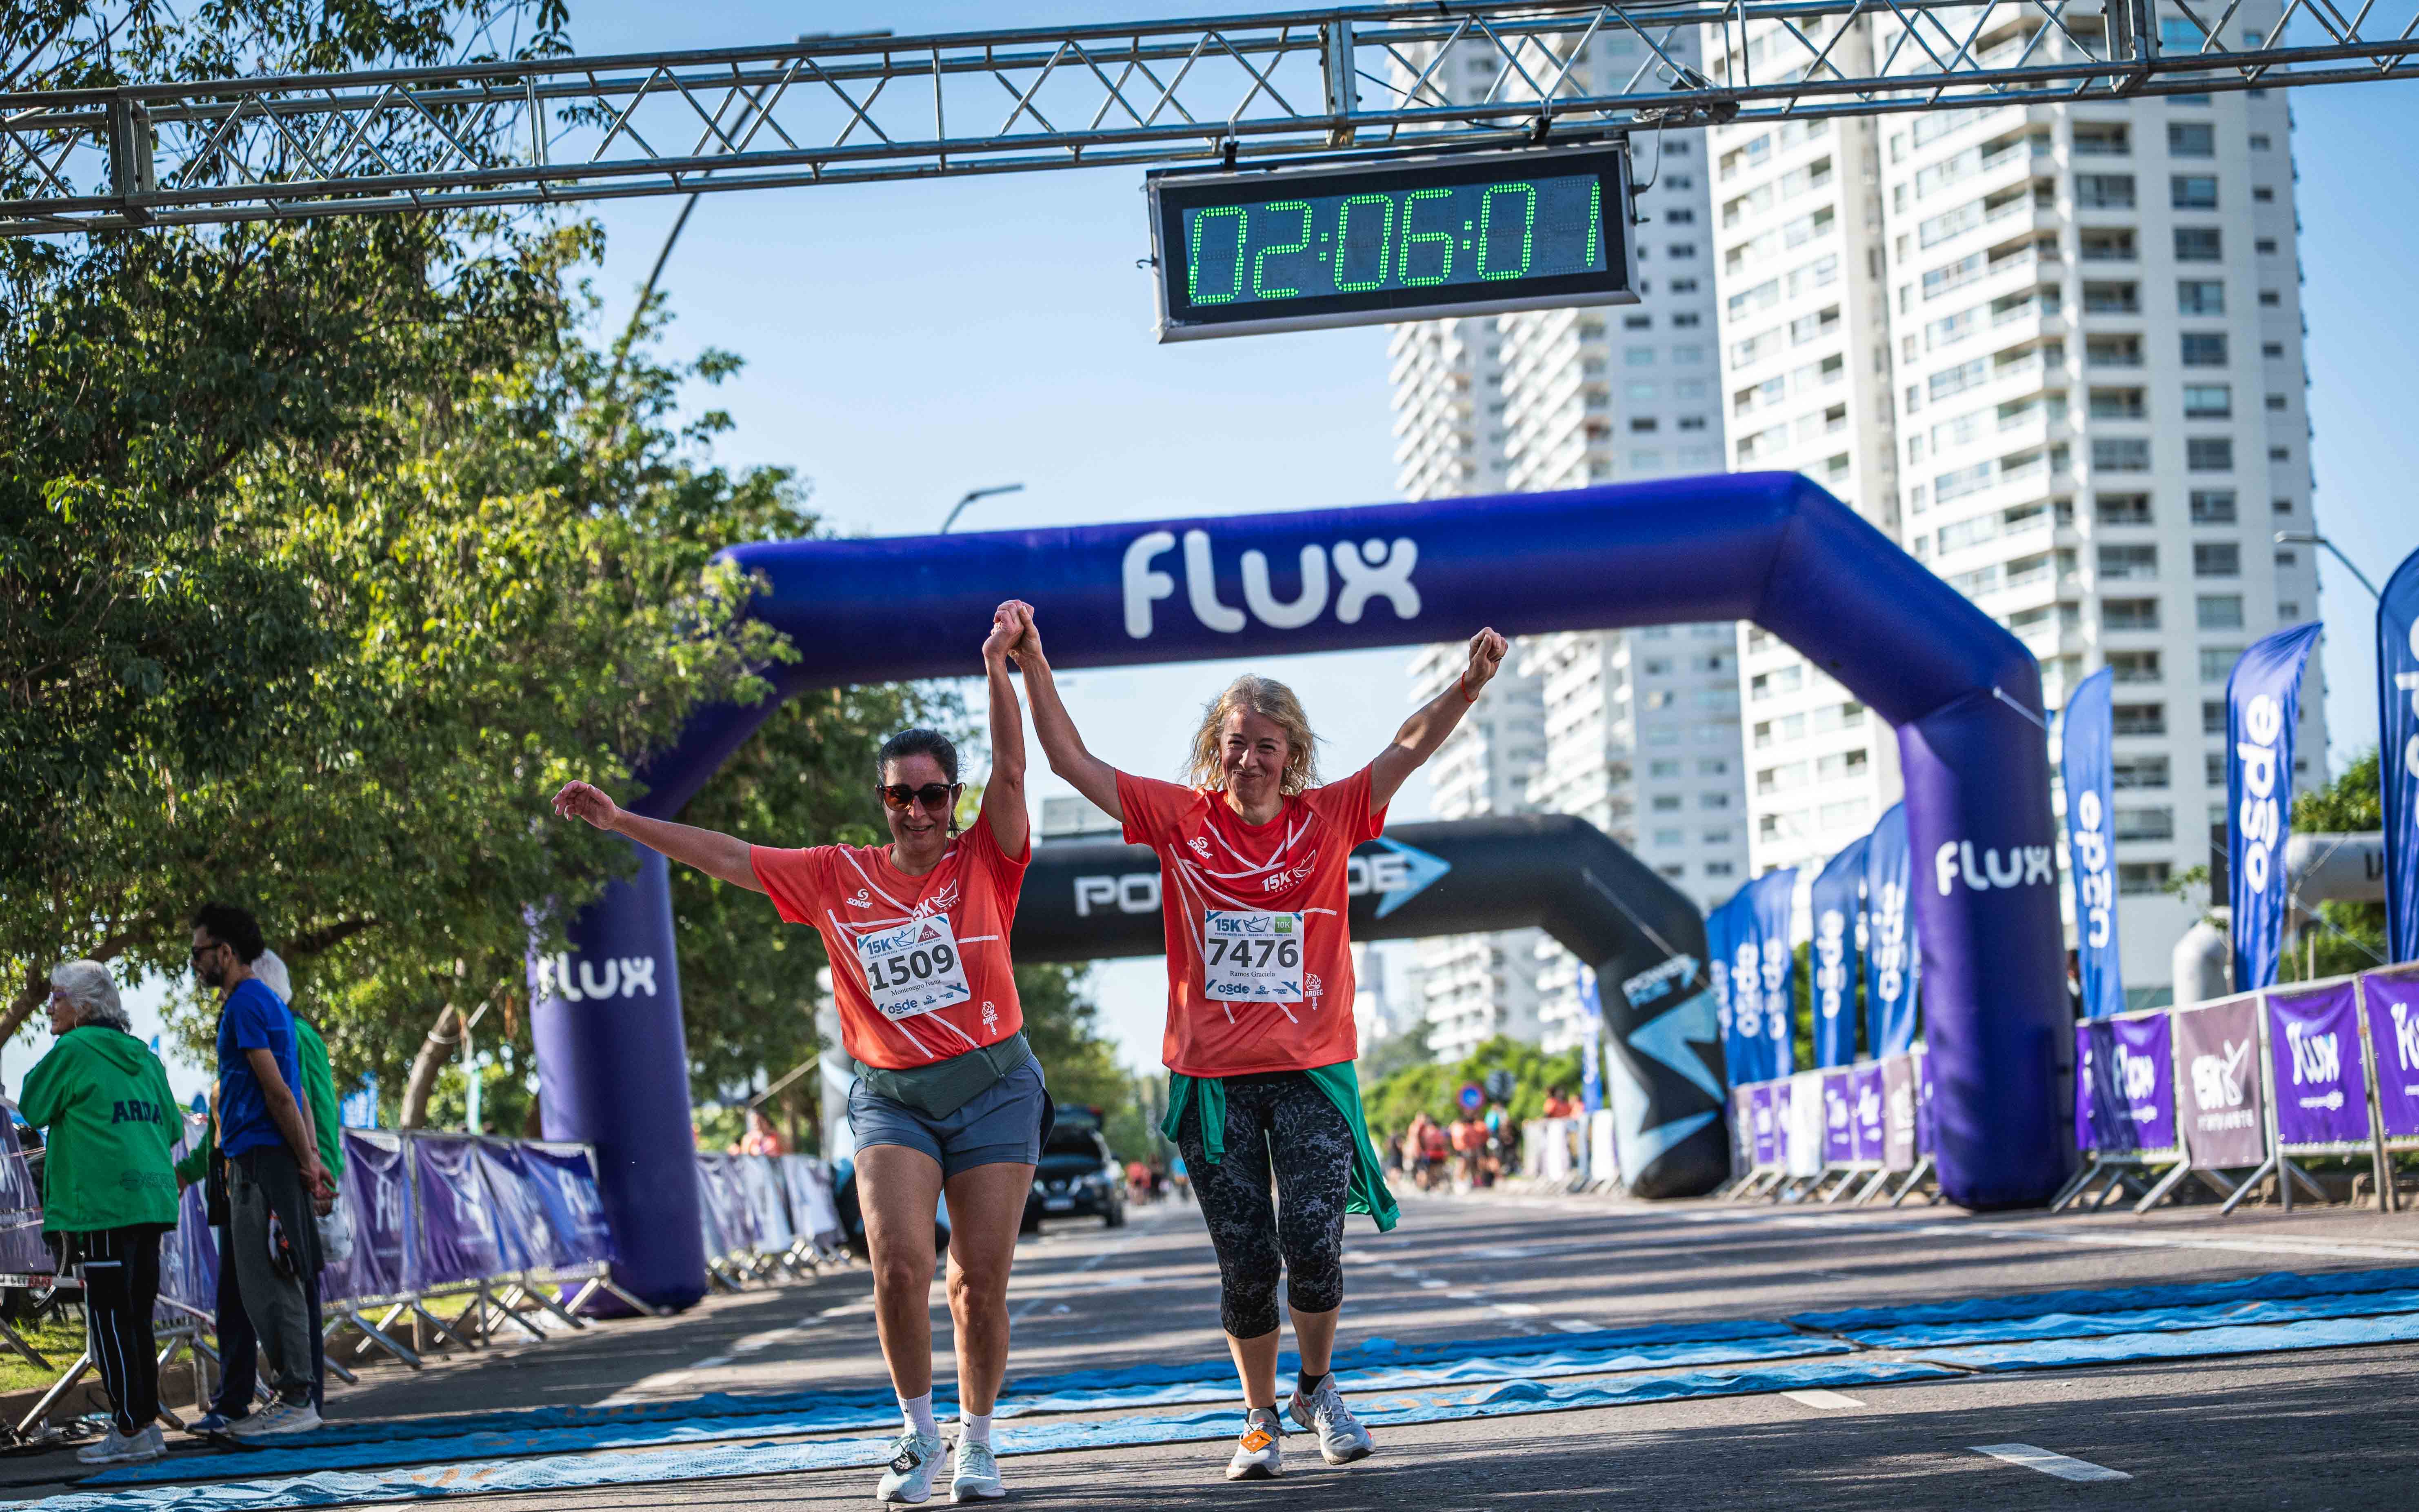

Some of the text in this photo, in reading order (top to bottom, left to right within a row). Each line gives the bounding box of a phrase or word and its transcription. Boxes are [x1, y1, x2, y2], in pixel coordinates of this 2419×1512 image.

[1188, 182, 1601, 304] 02:06:01
[1262, 870, 1292, 892] 15K
[1215, 918, 1241, 933] 15K
[922, 930, 936, 939] 15K
[866, 937, 893, 955] 15K
[1208, 938, 1299, 968] 7476
[867, 944, 954, 991] 1509
[891, 984, 924, 996] Montenegro
[1218, 983, 1250, 995] osde
[1305, 989, 1323, 997] ARDEC
[888, 999, 918, 1014] osde
[983, 1013, 998, 1026] ARDEC
